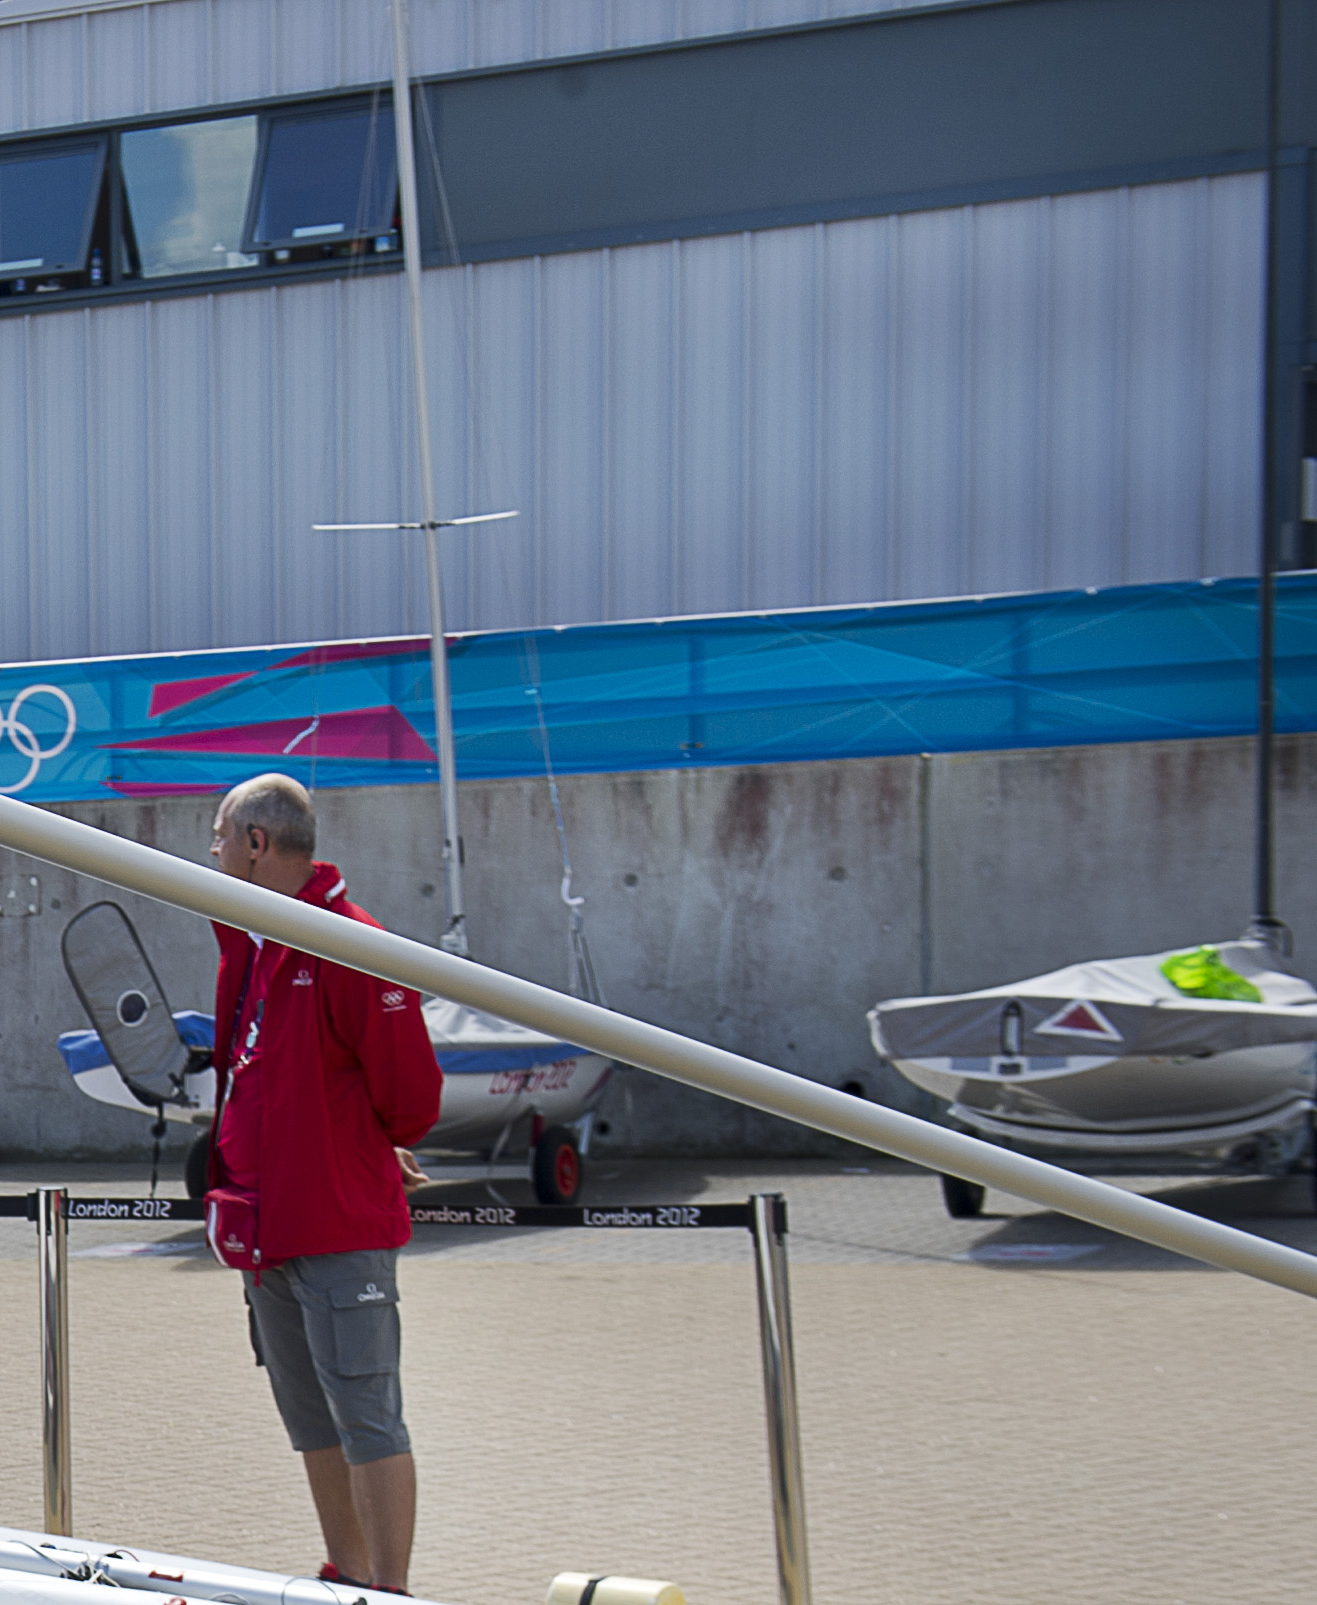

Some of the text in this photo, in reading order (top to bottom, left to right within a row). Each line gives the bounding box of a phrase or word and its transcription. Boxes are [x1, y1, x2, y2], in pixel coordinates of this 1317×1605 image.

[68, 1198, 172, 1218] London 2012
[407, 1205, 517, 1225] London 2012
[582, 1206, 702, 1226] London 2012
